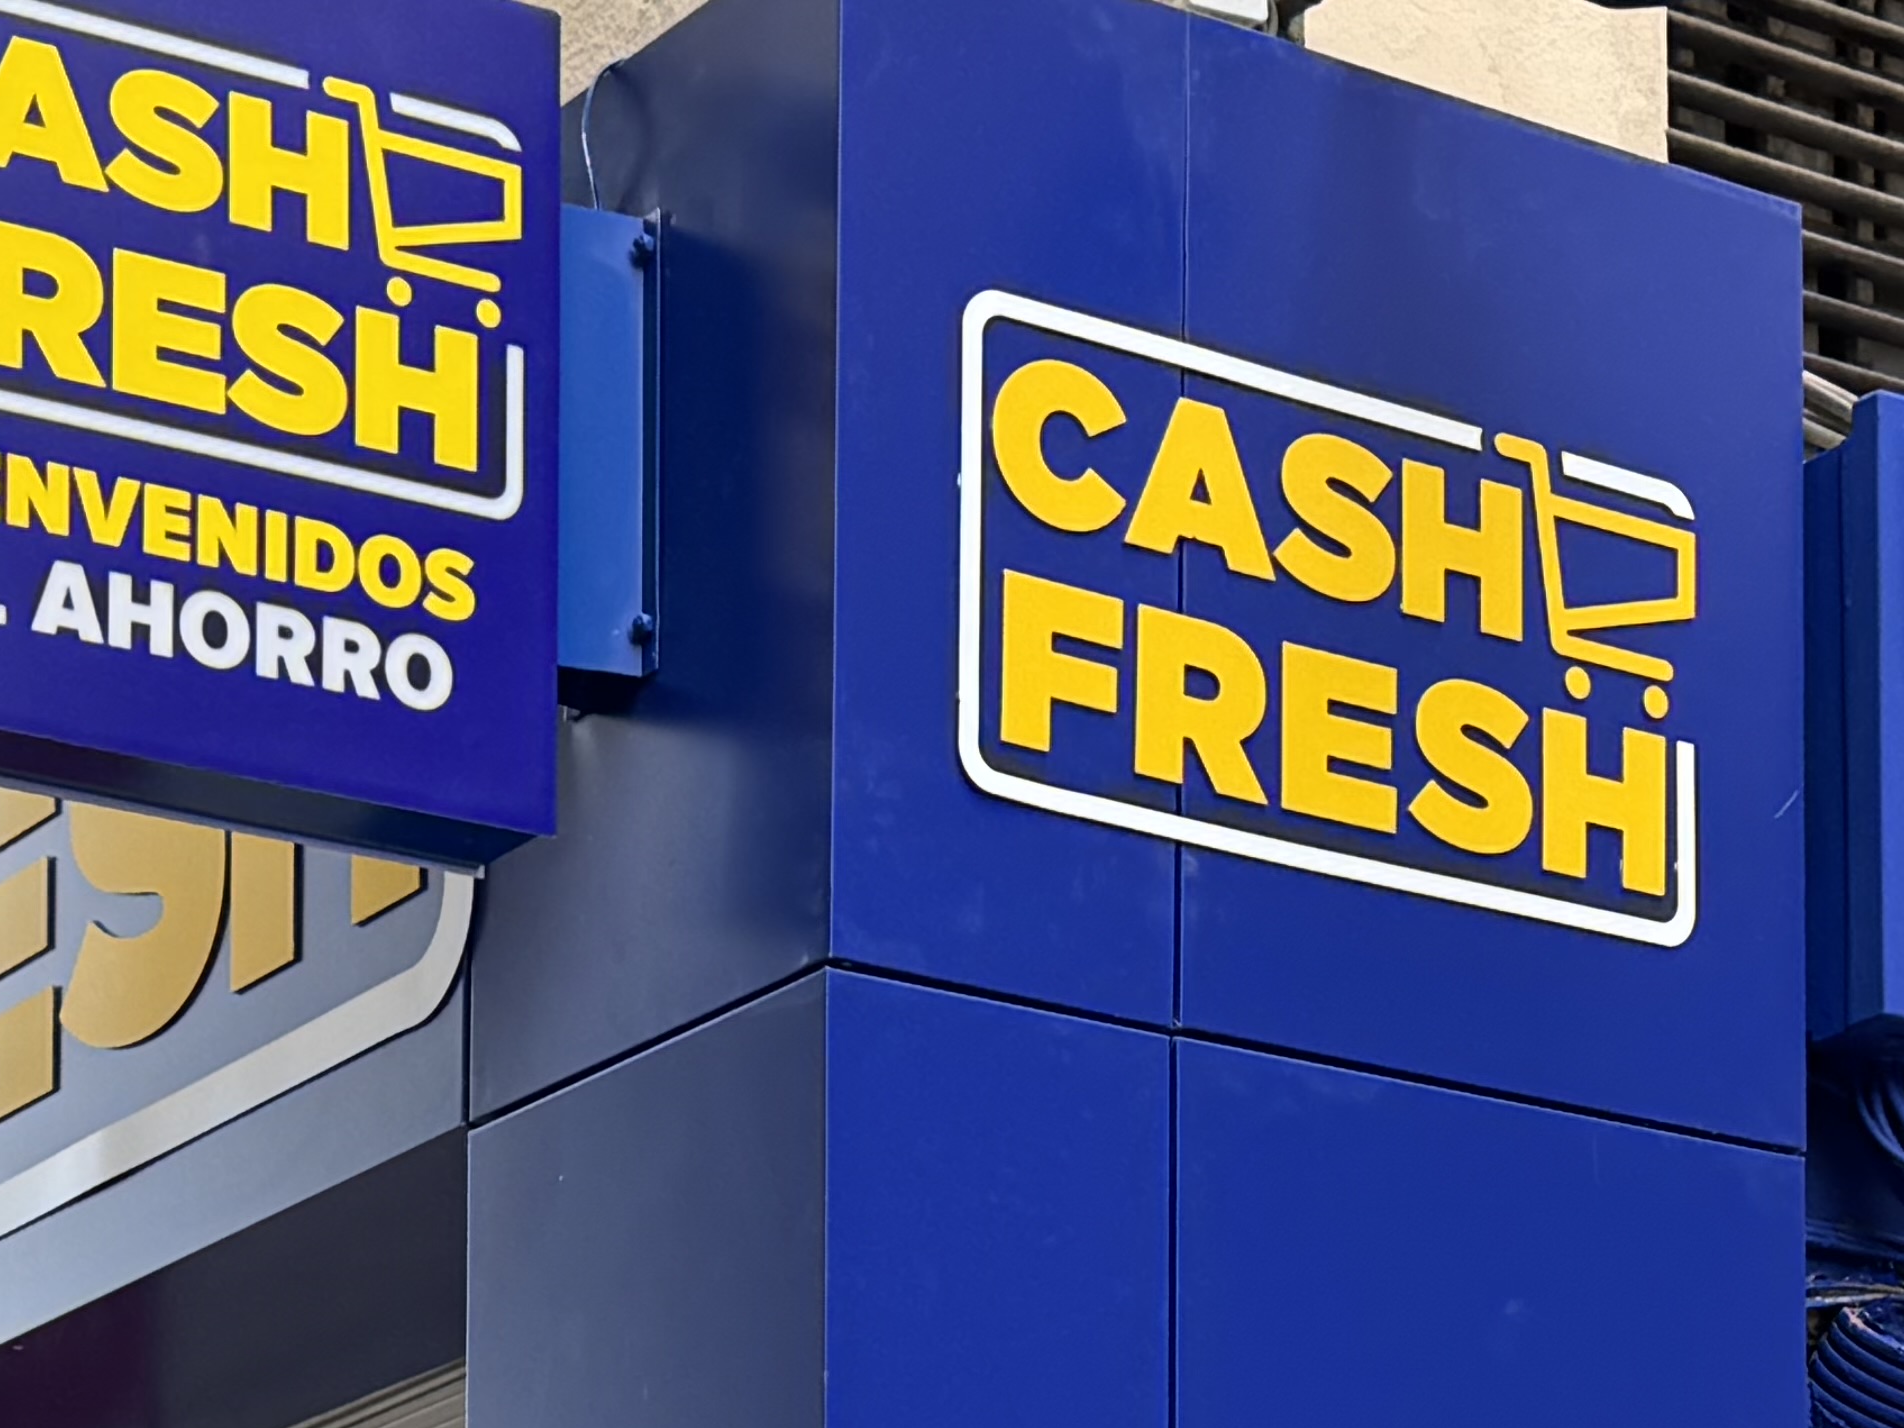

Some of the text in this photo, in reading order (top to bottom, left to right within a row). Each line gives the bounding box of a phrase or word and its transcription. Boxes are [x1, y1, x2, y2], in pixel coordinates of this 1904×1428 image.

[31, 560, 455, 712] AHORRO
[992, 359, 1524, 643] CASH
[1000, 569, 1666, 897] FRESH
